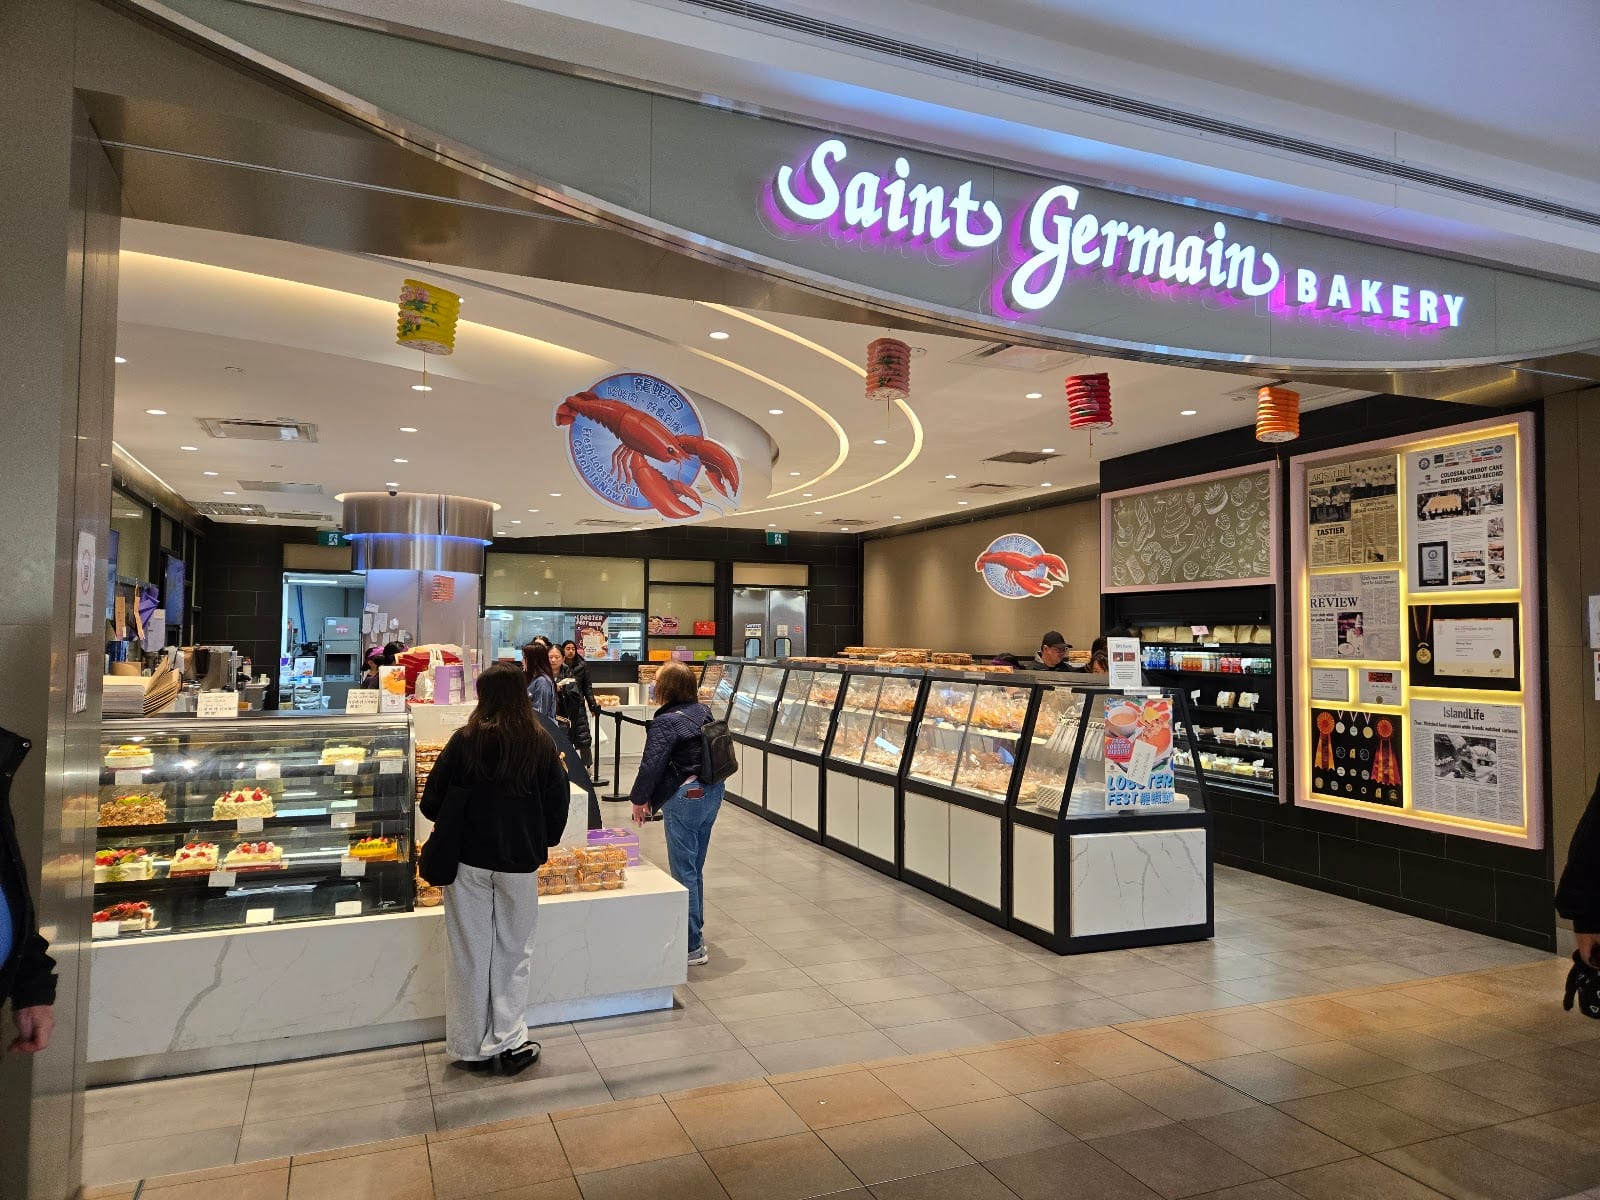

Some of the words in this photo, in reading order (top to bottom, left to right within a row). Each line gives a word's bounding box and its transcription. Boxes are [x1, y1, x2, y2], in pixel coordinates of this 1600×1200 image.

[778, 139, 1002, 248] Saint
[1010, 185, 1279, 310] Germain
[1296, 268, 1465, 328] BAKERY
[633, 376, 684, 413] 龍蝦包
[581, 427, 595, 458] Fresh
[589, 455, 620, 488] Lobster
[619, 483, 640, 498] Roll
[572, 439, 592, 475] Catch
[596, 479, 627, 504] Now!
[1440, 469, 1466, 479] COLOSSAL
[1466, 466, 1488, 475] CARROT
[1488, 463, 1504, 471] CAKE
[1463, 473, 1482, 481] WORLD
[1482, 470, 1504, 479] RECORD
[1317, 526, 1345, 537] TASTIER
[1310, 596, 1359, 609] REVIEW
[1443, 706, 1485, 721] IslandLife
[1107, 791, 1138, 806] FEST
